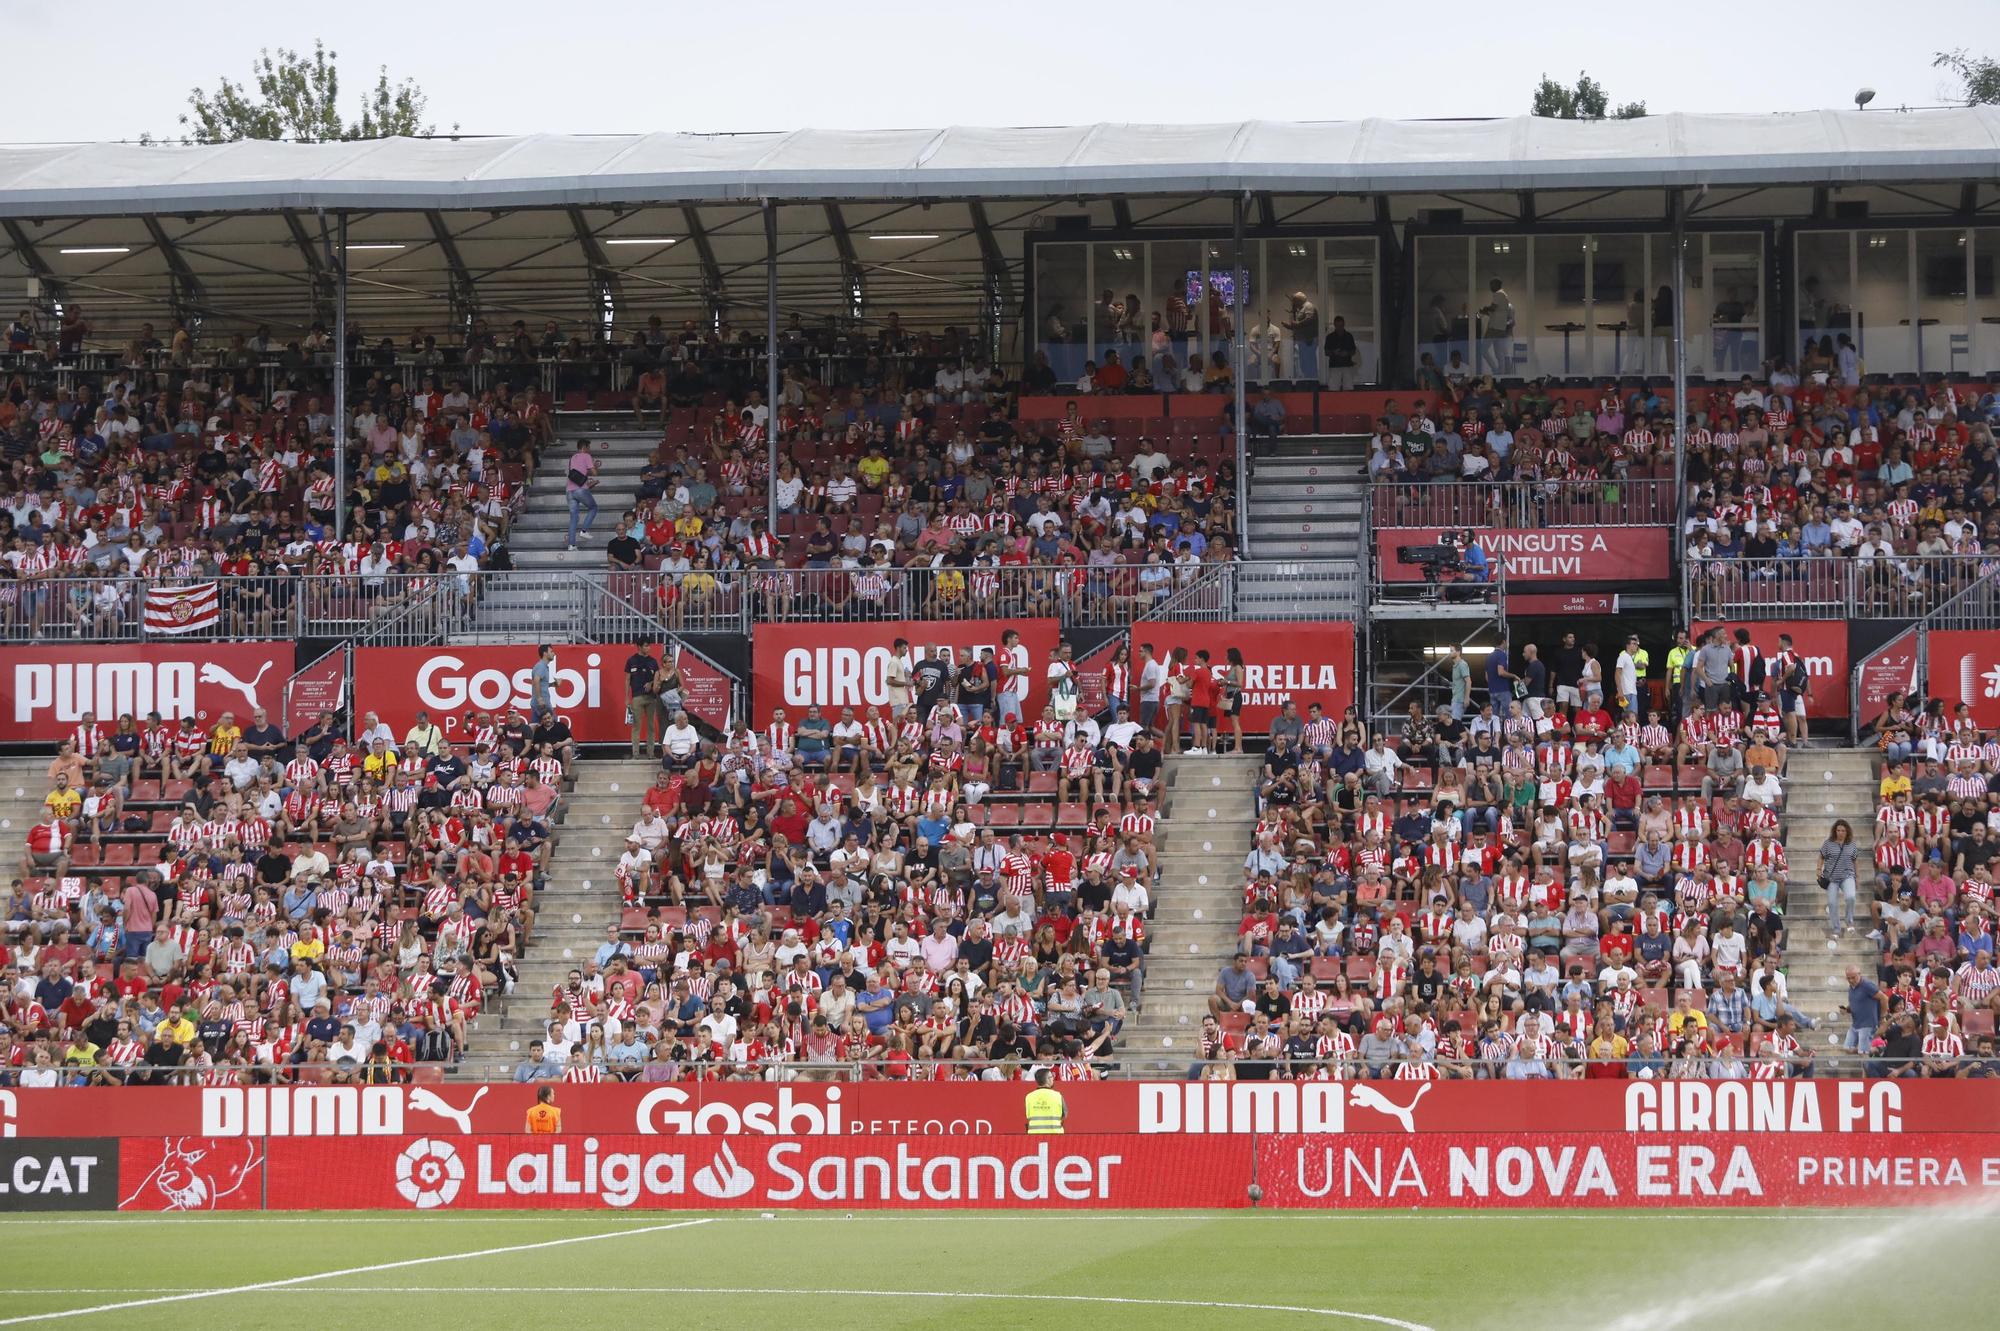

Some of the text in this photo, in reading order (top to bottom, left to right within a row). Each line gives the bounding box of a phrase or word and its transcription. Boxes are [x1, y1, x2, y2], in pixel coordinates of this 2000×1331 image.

[1438, 534, 1607, 552] NVINGUTS A
[1486, 557, 1581, 574] NTILIVI
[15, 662, 195, 722] PUMA
[416, 653, 601, 710] Gosbi
[784, 646, 957, 706] GIRO
[1241, 693, 1291, 706] DAMM
[636, 1086, 841, 1135] Gosbi
[851, 1119, 992, 1135] PETFOOD
[1625, 1081, 1902, 1132] GIRONA FC
[478, 1137, 685, 1207] LaLiga
[766, 1142, 1122, 1200] Santander
[1297, 1146, 1764, 1197] UNA NOVA ERA
[1798, 1156, 1967, 1186] PRIMERA
